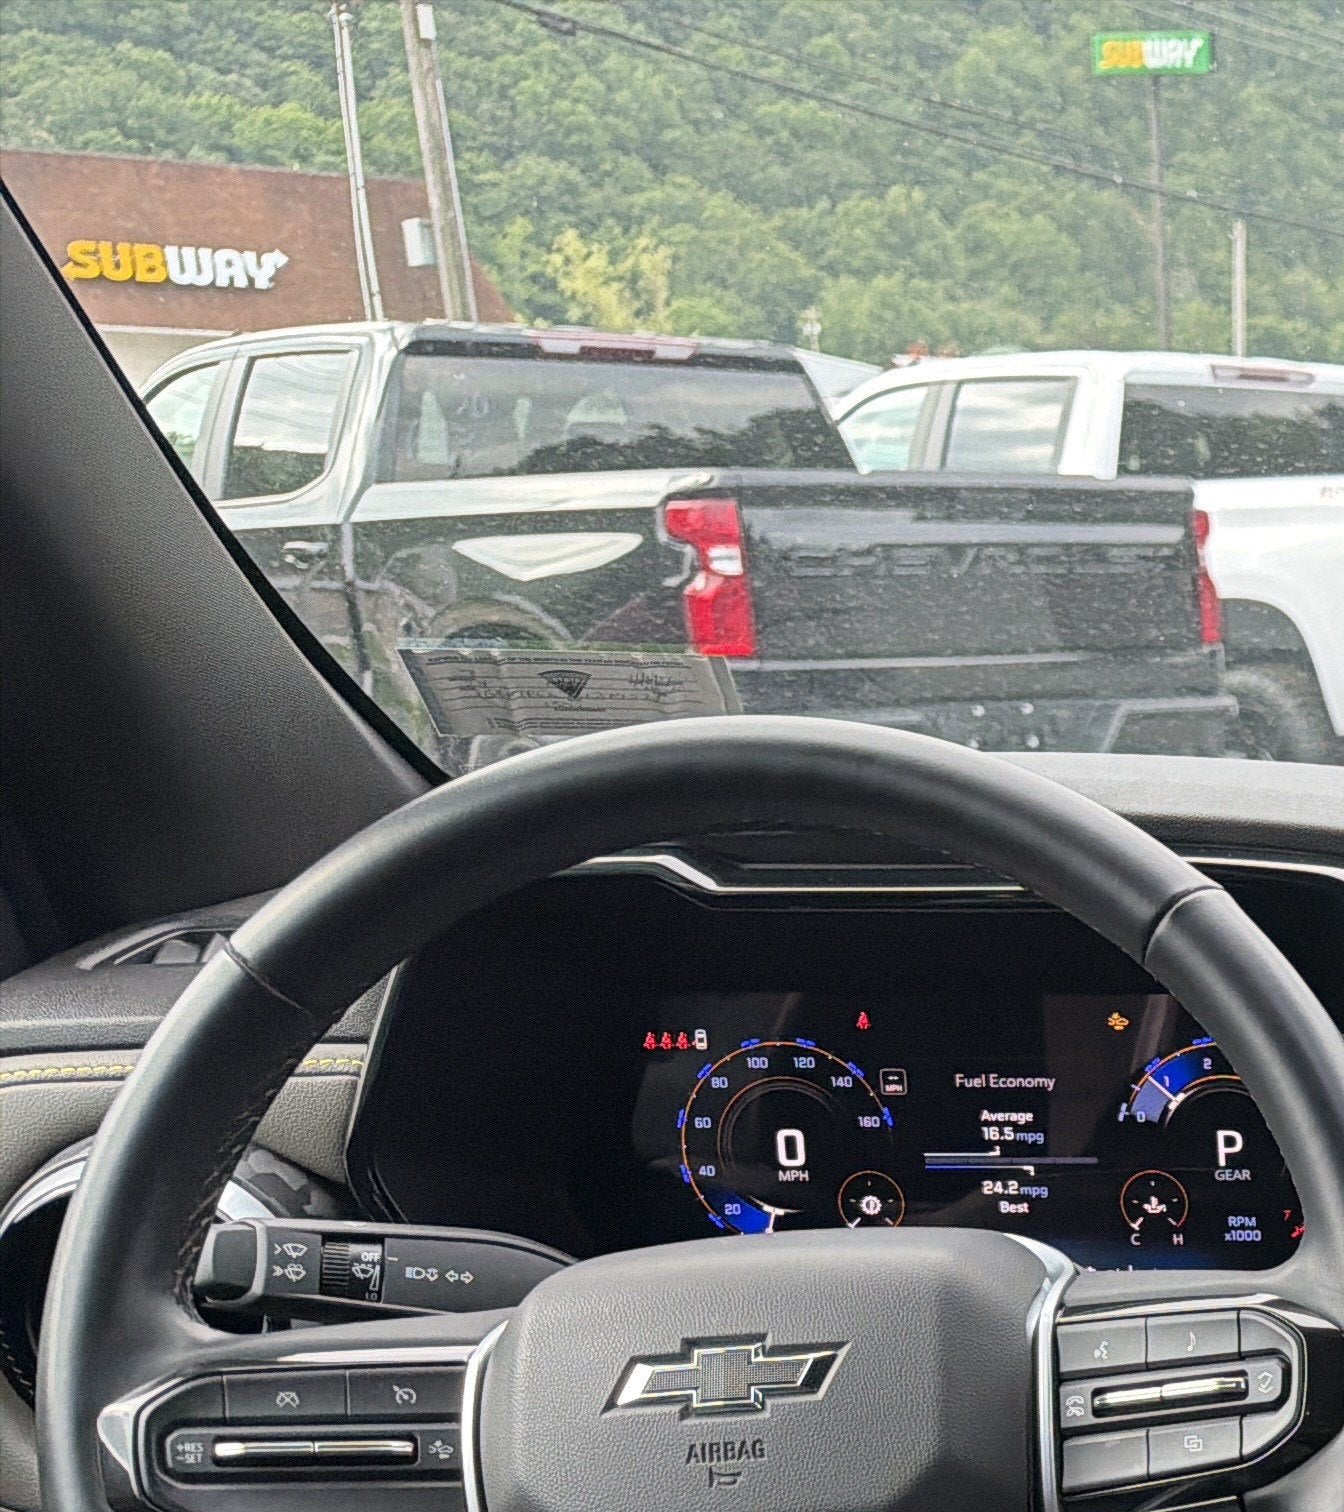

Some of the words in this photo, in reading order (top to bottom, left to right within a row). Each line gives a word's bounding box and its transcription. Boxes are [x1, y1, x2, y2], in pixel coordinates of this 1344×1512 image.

[1100, 38, 1204, 69] SUBWAY
[61, 239, 289, 290] SUBWAY
[746, 1057, 769, 1069] 100
[793, 1057, 816, 1069] 120
[1203, 1058, 1213, 1070] 2
[711, 1077, 728, 1089] 80
[830, 1076, 853, 1088] 140
[955, 1073, 986, 1088] Fuel
[989, 1073, 1056, 1091] Economy
[694, 1117, 711, 1129] 60
[857, 1116, 881, 1128] 160
[980, 1109, 1034, 1125] Average
[1136, 1111, 1146, 1123] 0
[981, 1126, 1015, 1141] 16.5
[1016, 1131, 1045, 1144] mpg
[776, 1128, 806, 1167] 0
[1216, 1129, 1243, 1167] P
[698, 1165, 716, 1177] 40
[778, 1170, 809, 1182] MPH
[1214, 1169, 1251, 1181] GEAR
[982, 1180, 1019, 1195] 24.2
[1020, 1185, 1049, 1199] mpg
[724, 1203, 741, 1215] 20
[999, 1201, 1030, 1214] Best
[1227, 1215, 1257, 1227] RPM
[1224, 1229, 1262, 1242] x1000
[361, 1251, 381, 1263] OFF
[685, 1438, 766, 1465] AIRBAG
